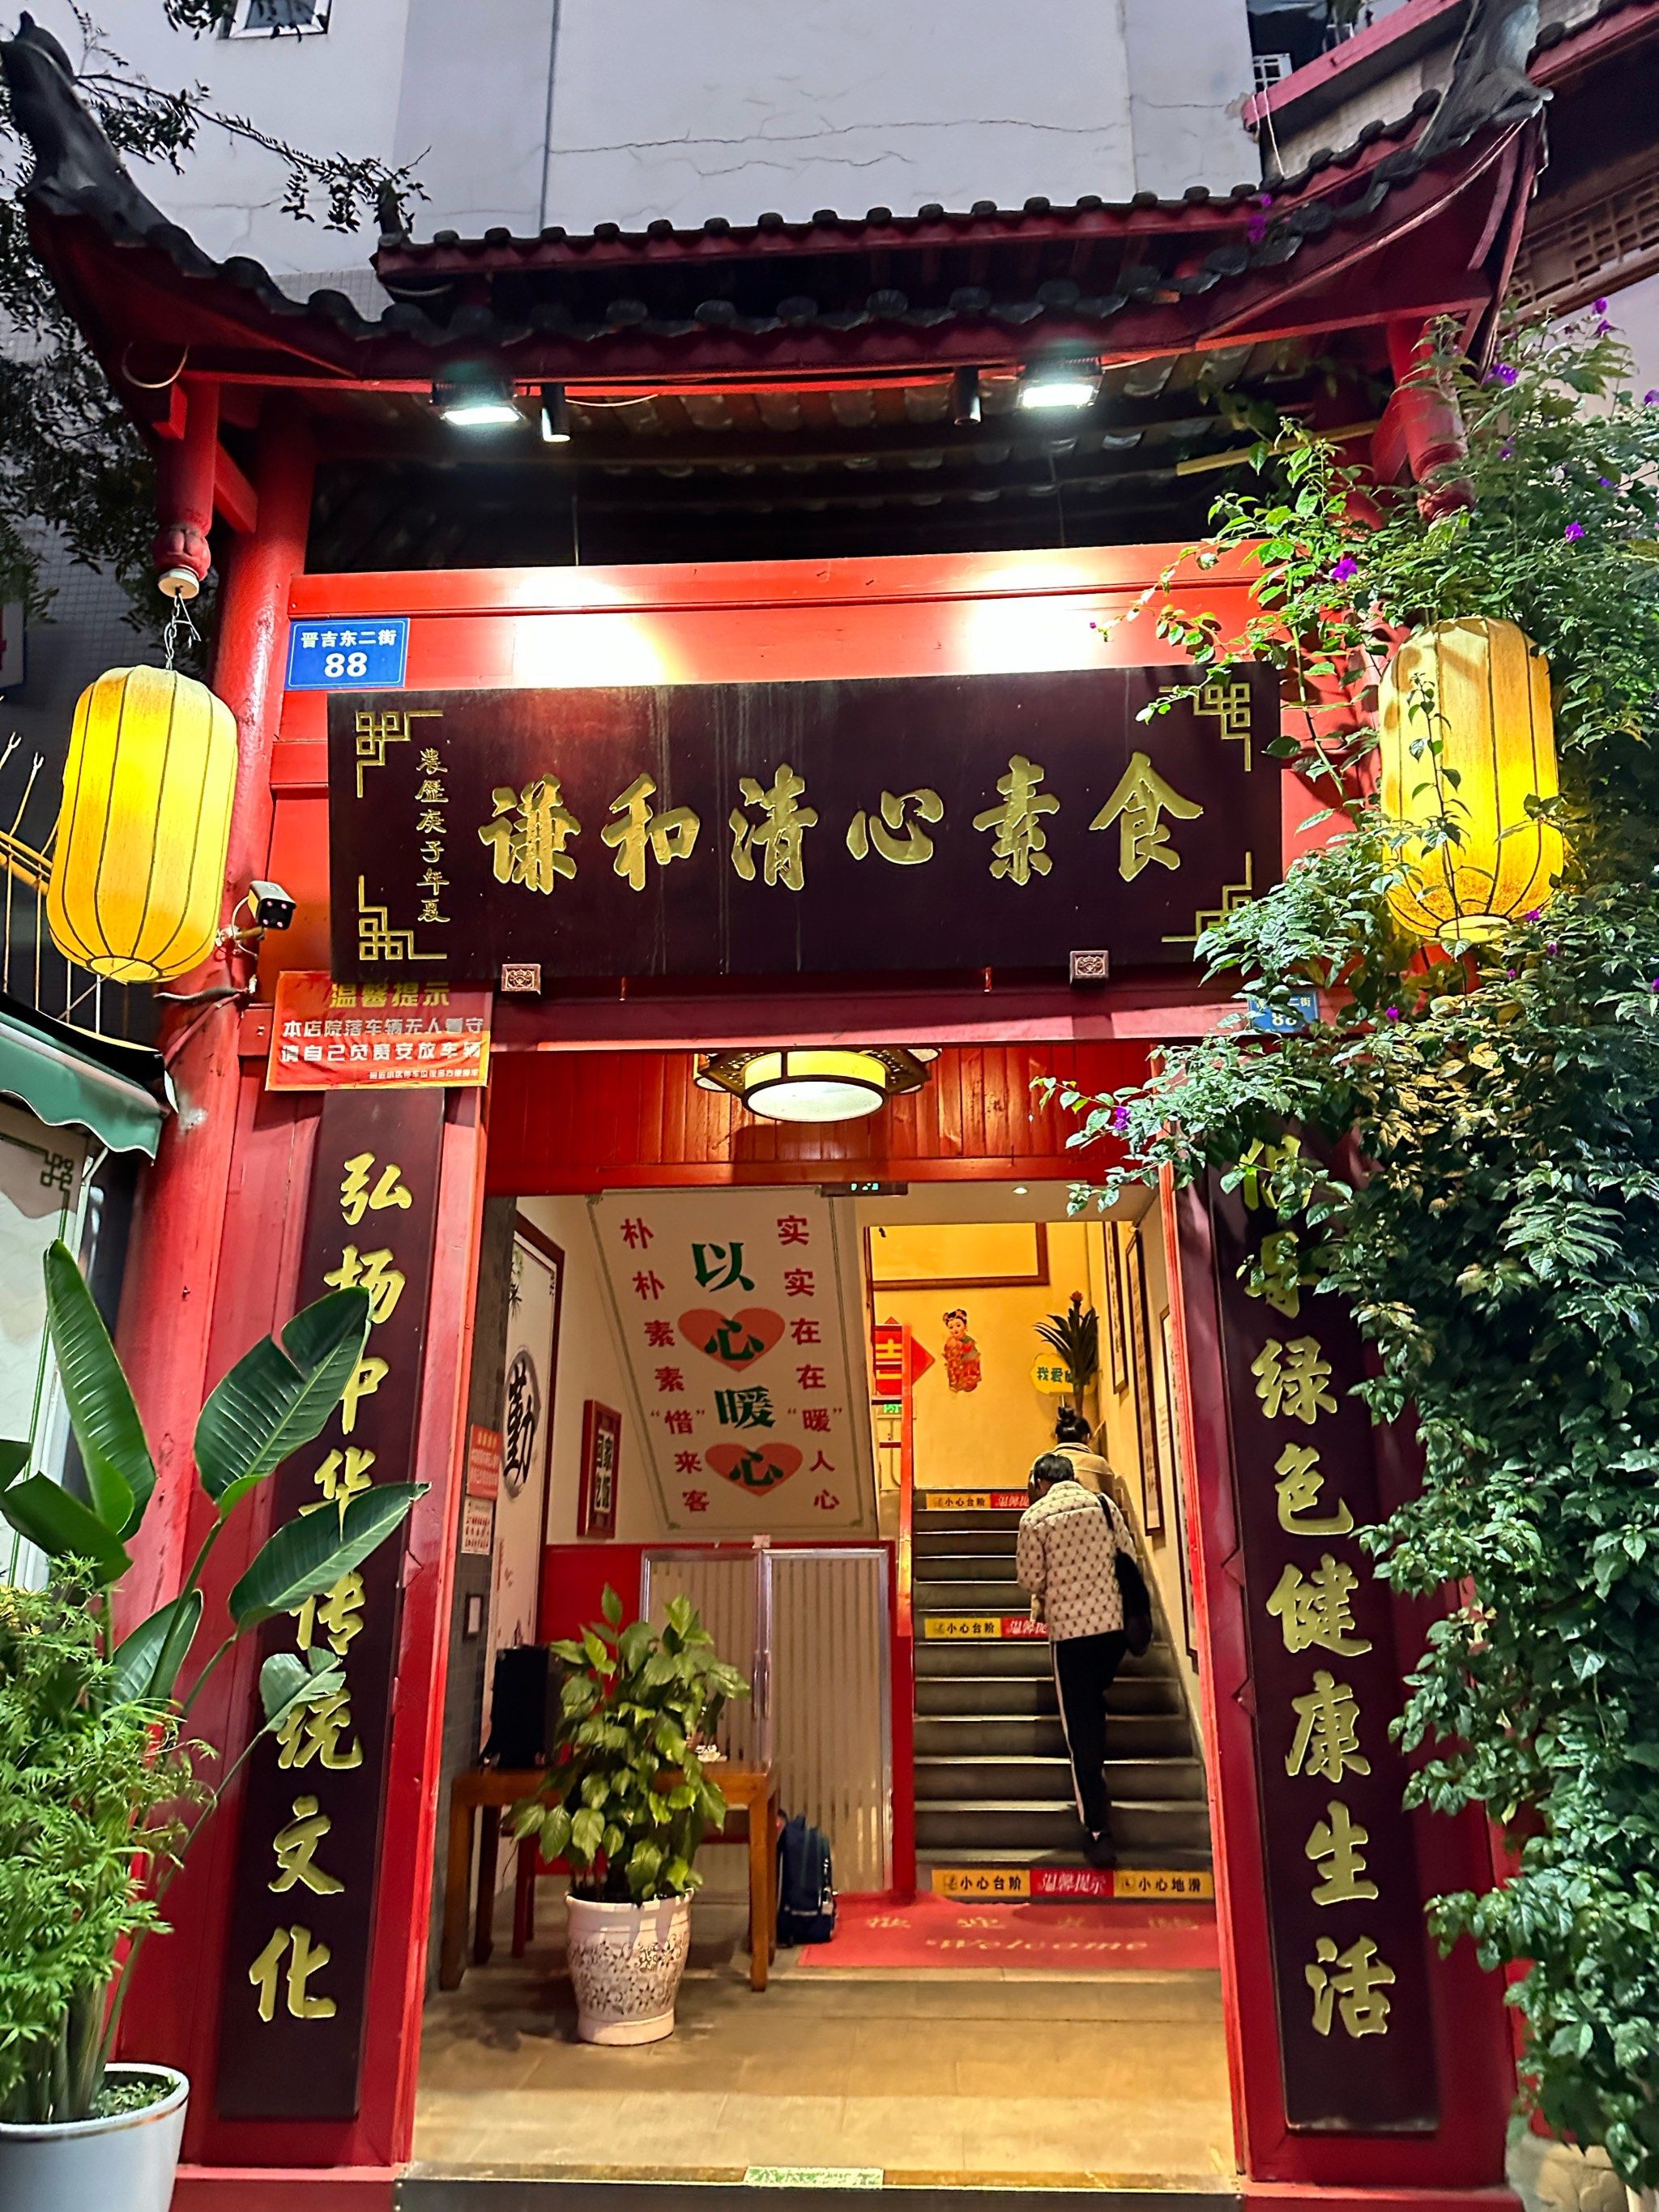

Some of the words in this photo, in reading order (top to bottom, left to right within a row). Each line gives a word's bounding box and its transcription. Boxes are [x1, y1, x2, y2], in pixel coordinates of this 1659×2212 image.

[301, 629, 397, 648] 晋吉东二街
[324, 651, 368, 678] 88
[478, 750, 1205, 895] 谦和清心素食
[328, 982, 450, 1009] 温馨提示
[282, 1017, 484, 1038] 本店院落车辆无人看守
[280, 1040, 482, 1063] 请自己负责安放车辆
[691, 1241, 785, 1488] 以心暖心
[945, 1497, 986, 1507] 小心台阶
[947, 1622, 995, 1633] 小心台阶
[961, 1875, 1021, 1890] 小心台阶
[1138, 1877, 1201, 1892] 小心地滑
